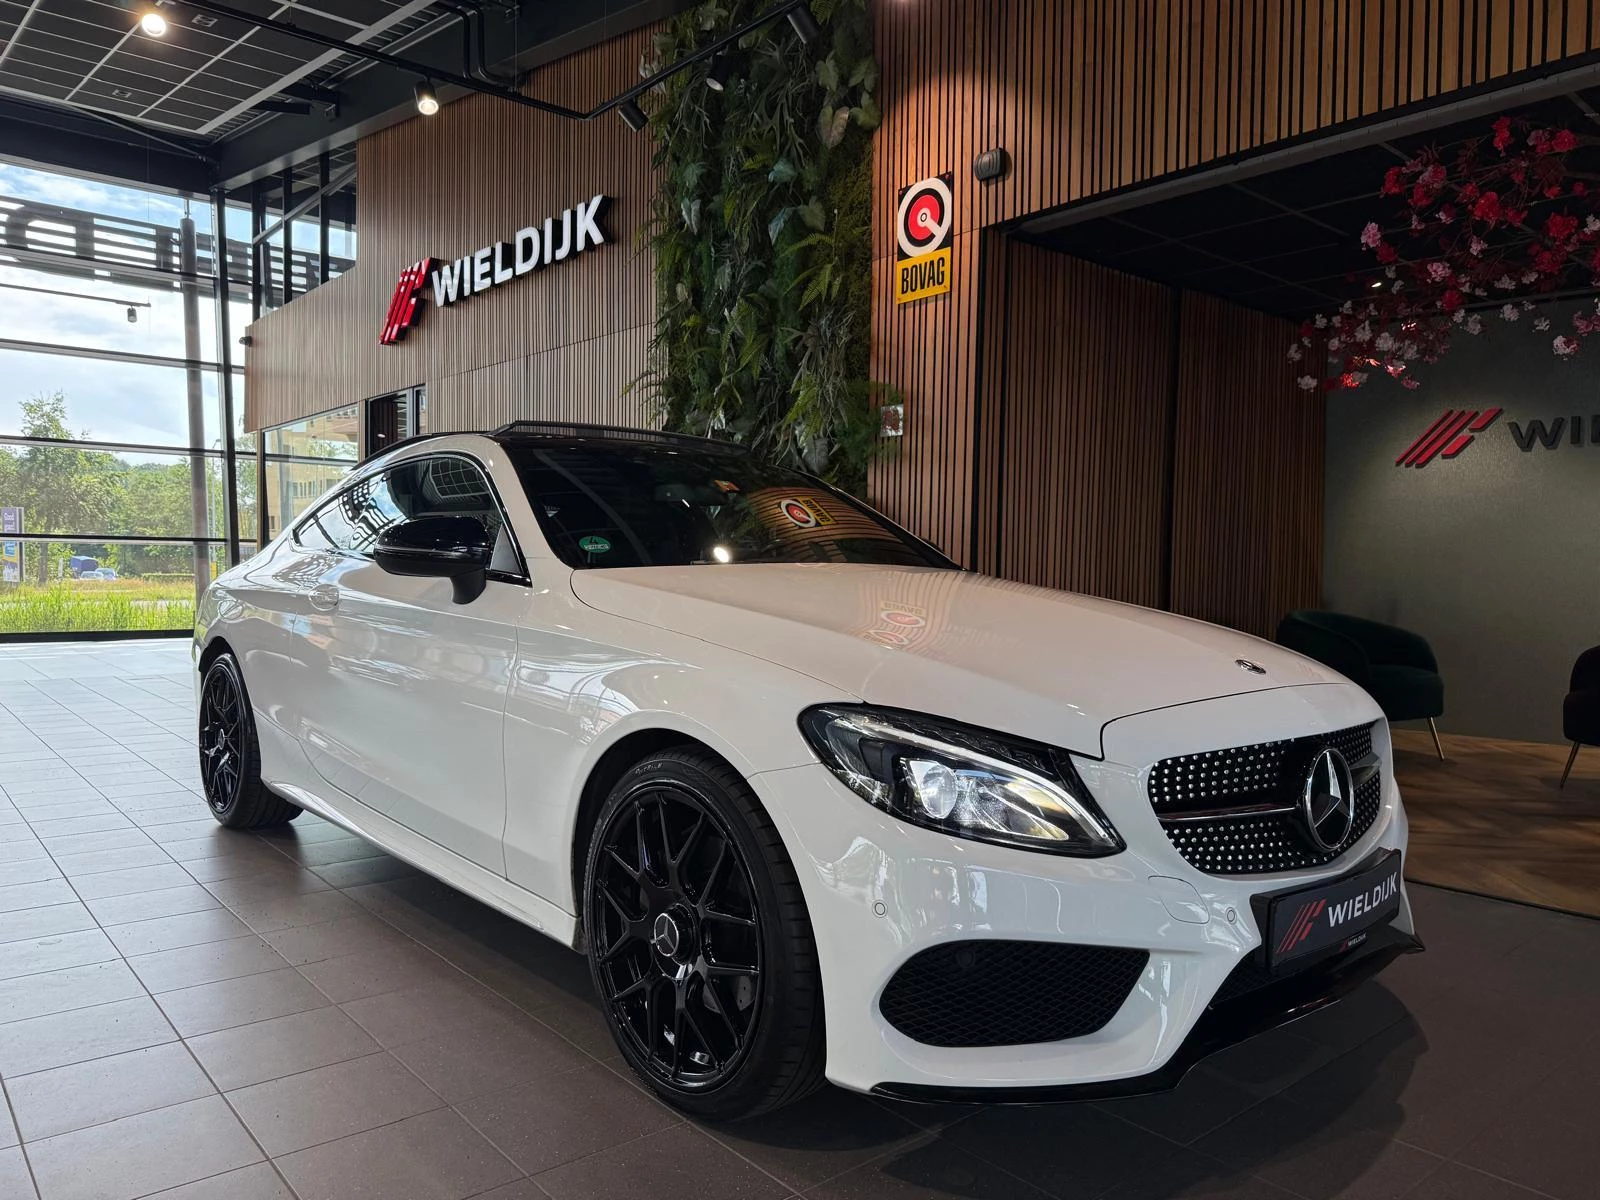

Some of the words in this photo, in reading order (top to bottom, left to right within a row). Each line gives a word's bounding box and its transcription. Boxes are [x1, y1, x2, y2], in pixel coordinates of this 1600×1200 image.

[431, 194, 606, 308] WIELDIJK
[901, 257, 945, 295] BOVAG
[1328, 872, 1397, 928] WIELDIJK
